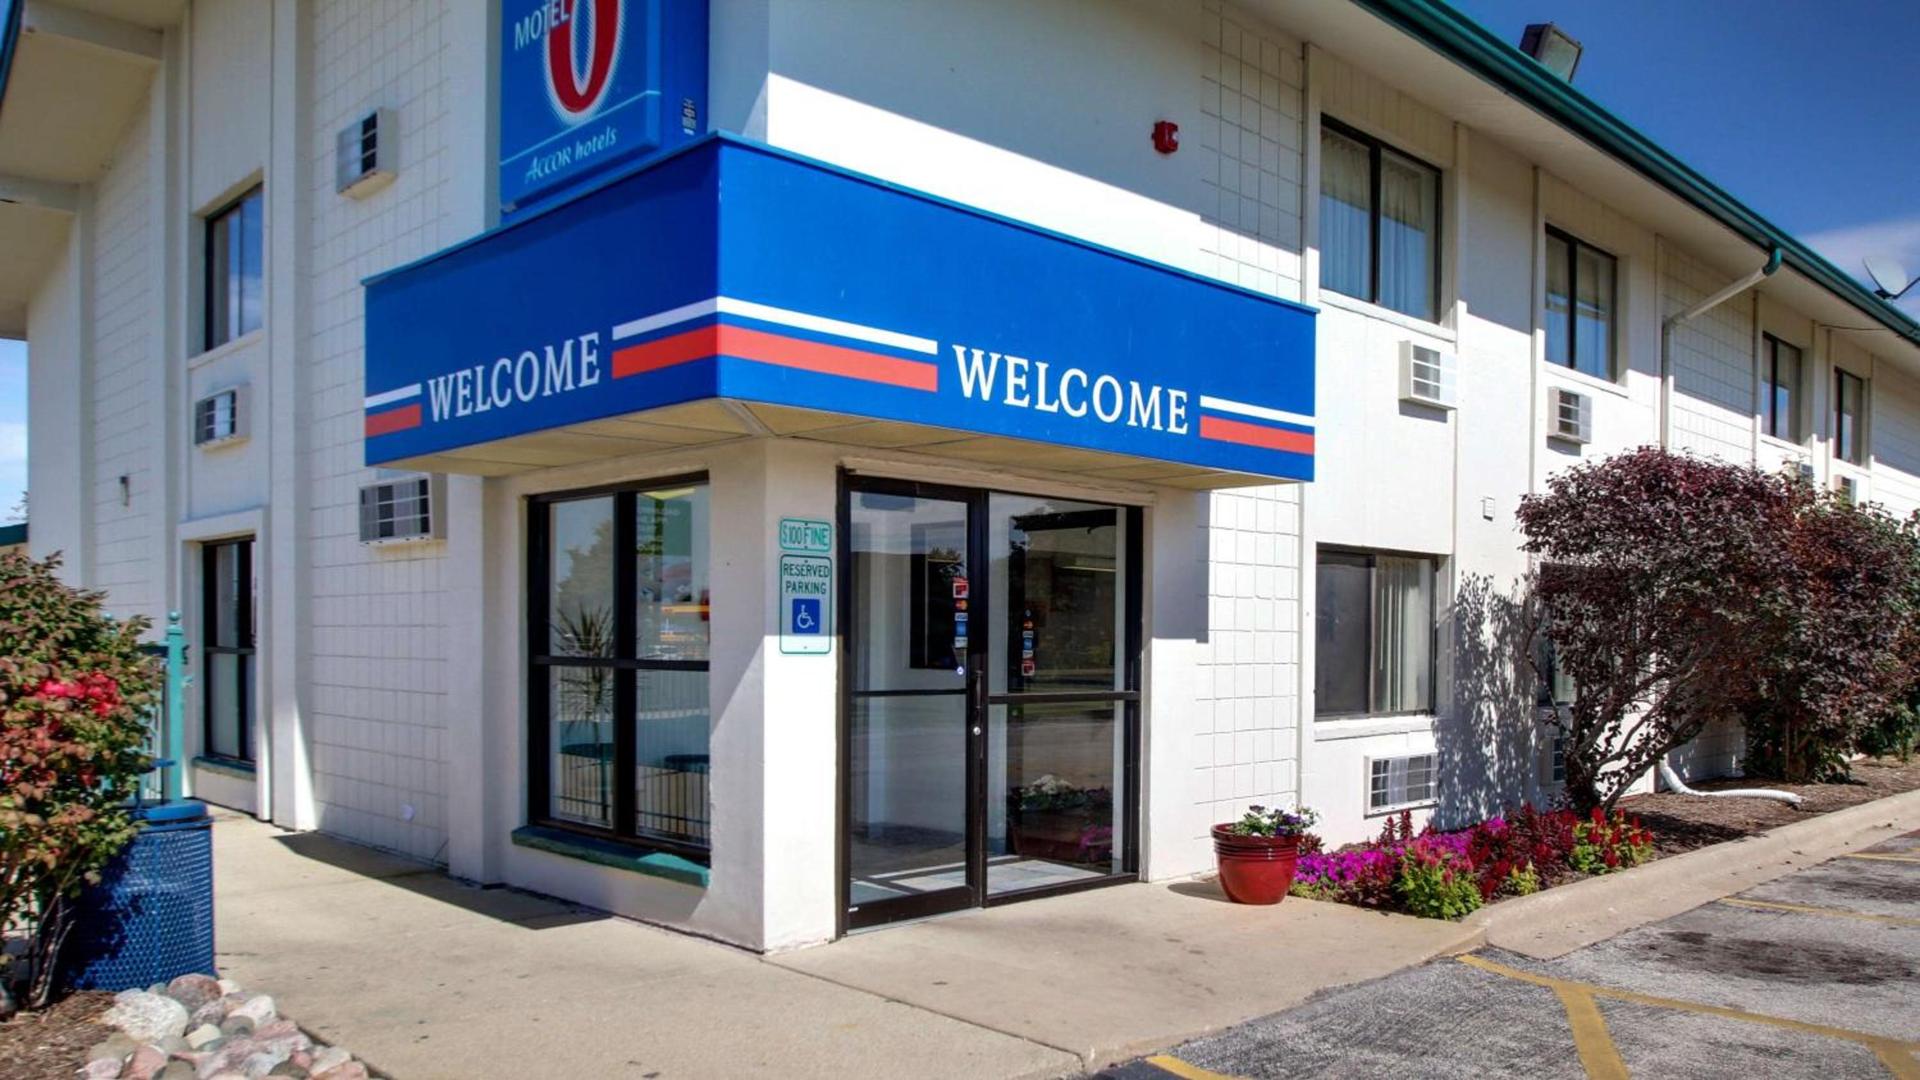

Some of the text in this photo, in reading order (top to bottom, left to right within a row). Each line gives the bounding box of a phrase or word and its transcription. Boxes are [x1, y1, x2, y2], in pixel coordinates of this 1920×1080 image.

[514, 0, 570, 51] MOTEL
[575, 125, 618, 161] hotels
[427, 331, 601, 423] WELCOME
[952, 344, 1189, 435] WELCOME
[803, 526, 829, 546] FINE
[783, 562, 830, 578] RESERVED
[785, 580, 827, 595] PARKING
